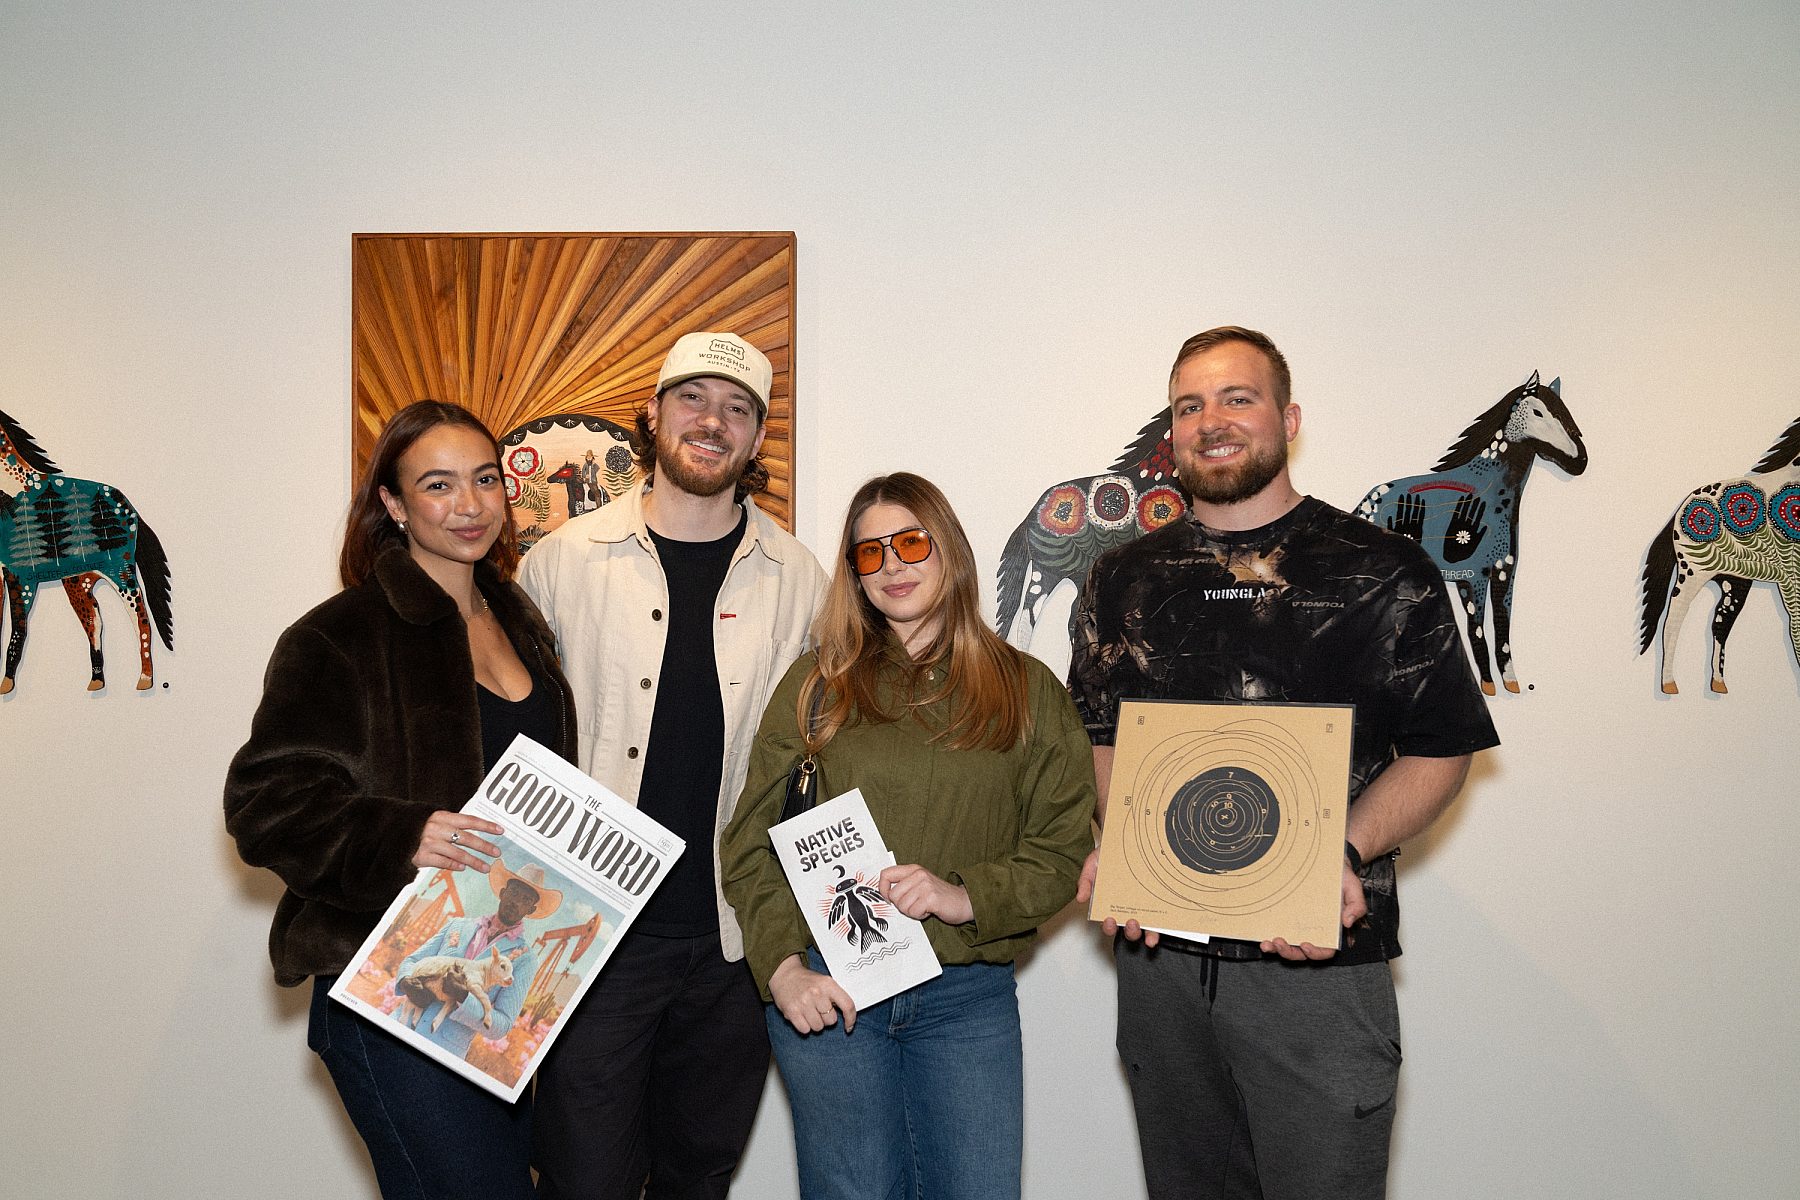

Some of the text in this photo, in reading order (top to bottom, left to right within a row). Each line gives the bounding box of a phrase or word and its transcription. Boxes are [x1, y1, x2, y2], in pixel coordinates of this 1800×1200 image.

[714, 343, 741, 355] HELMS
[699, 353, 751, 371] WORKSHOP
[707, 360, 730, 368] AUSTIN
[1440, 569, 1475, 580] THREAD
[1203, 587, 1266, 601] YOUNGLA
[1228, 771, 1234, 779] 7
[584, 795, 602, 811] THE
[485, 762, 661, 896] GOOD WORD
[794, 816, 856, 855] NATIVE
[799, 832, 865, 872] SPECIES
